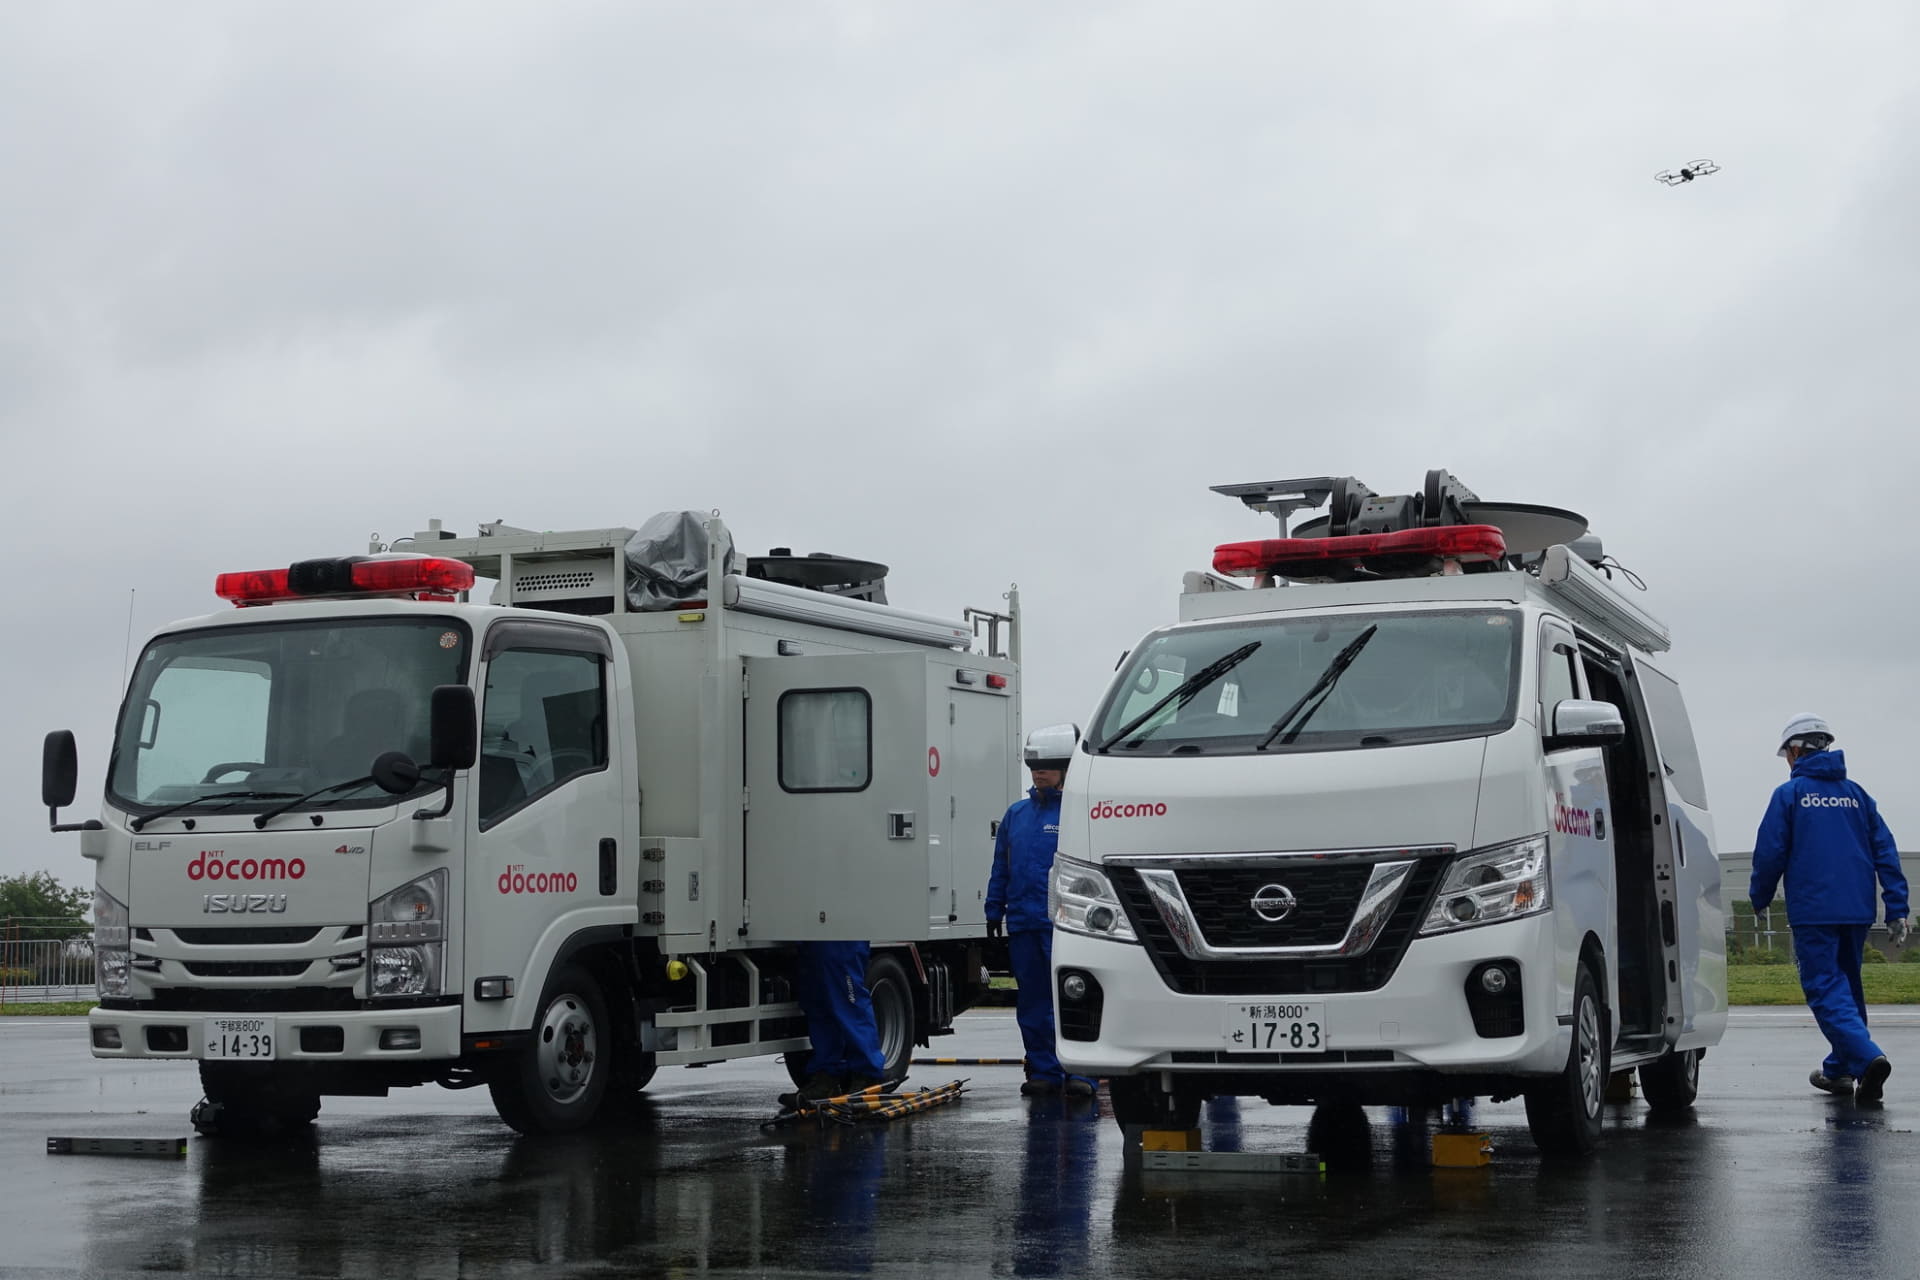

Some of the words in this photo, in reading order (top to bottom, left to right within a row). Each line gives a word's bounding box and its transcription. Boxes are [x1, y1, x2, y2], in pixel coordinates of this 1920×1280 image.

[1090, 801, 1167, 820] docomo
[1800, 793, 1859, 808] docomo
[1554, 791, 1591, 837] docomo
[134, 841, 171, 851] ELF
[207, 850, 225, 858] NTT
[187, 850, 306, 881] docomo
[498, 864, 578, 895] docomo
[203, 894, 287, 914] ISUZU
[222, 1034, 272, 1057] 14-39
[1252, 1022, 1320, 1049] 17-83
